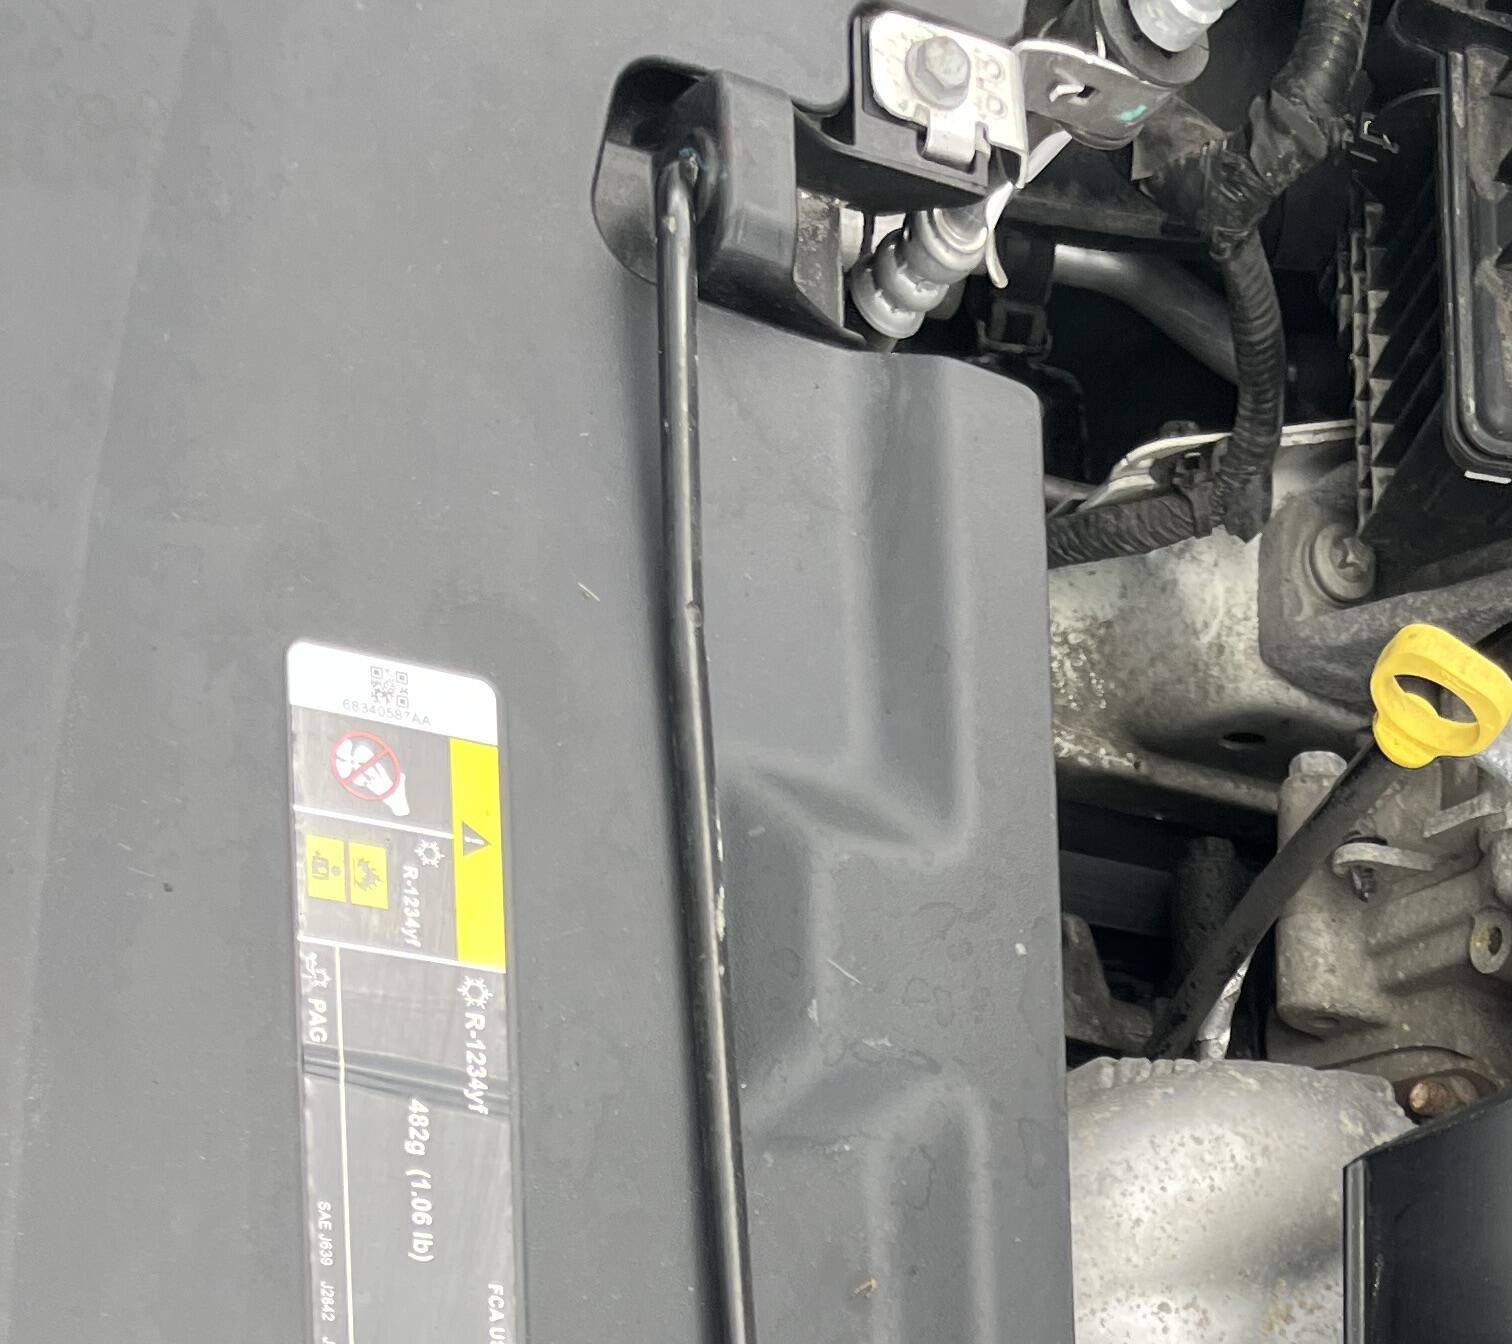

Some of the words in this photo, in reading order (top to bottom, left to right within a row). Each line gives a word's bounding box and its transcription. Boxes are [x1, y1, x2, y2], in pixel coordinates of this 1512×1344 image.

[400, 865, 421, 947] R-1234yf
[308, 998, 327, 1043] PAG
[463, 1012, 488, 1115] R-1234yf
[404, 1098, 430, 1156] 482g
[317, 1201, 331, 1230] SAE
[405, 1169, 434, 1226] (1.06
[319, 1234, 333, 1266] J639
[407, 1232, 434, 1263] lb)
[320, 1281, 334, 1322] J2842
[488, 1284, 505, 1321] FCA
